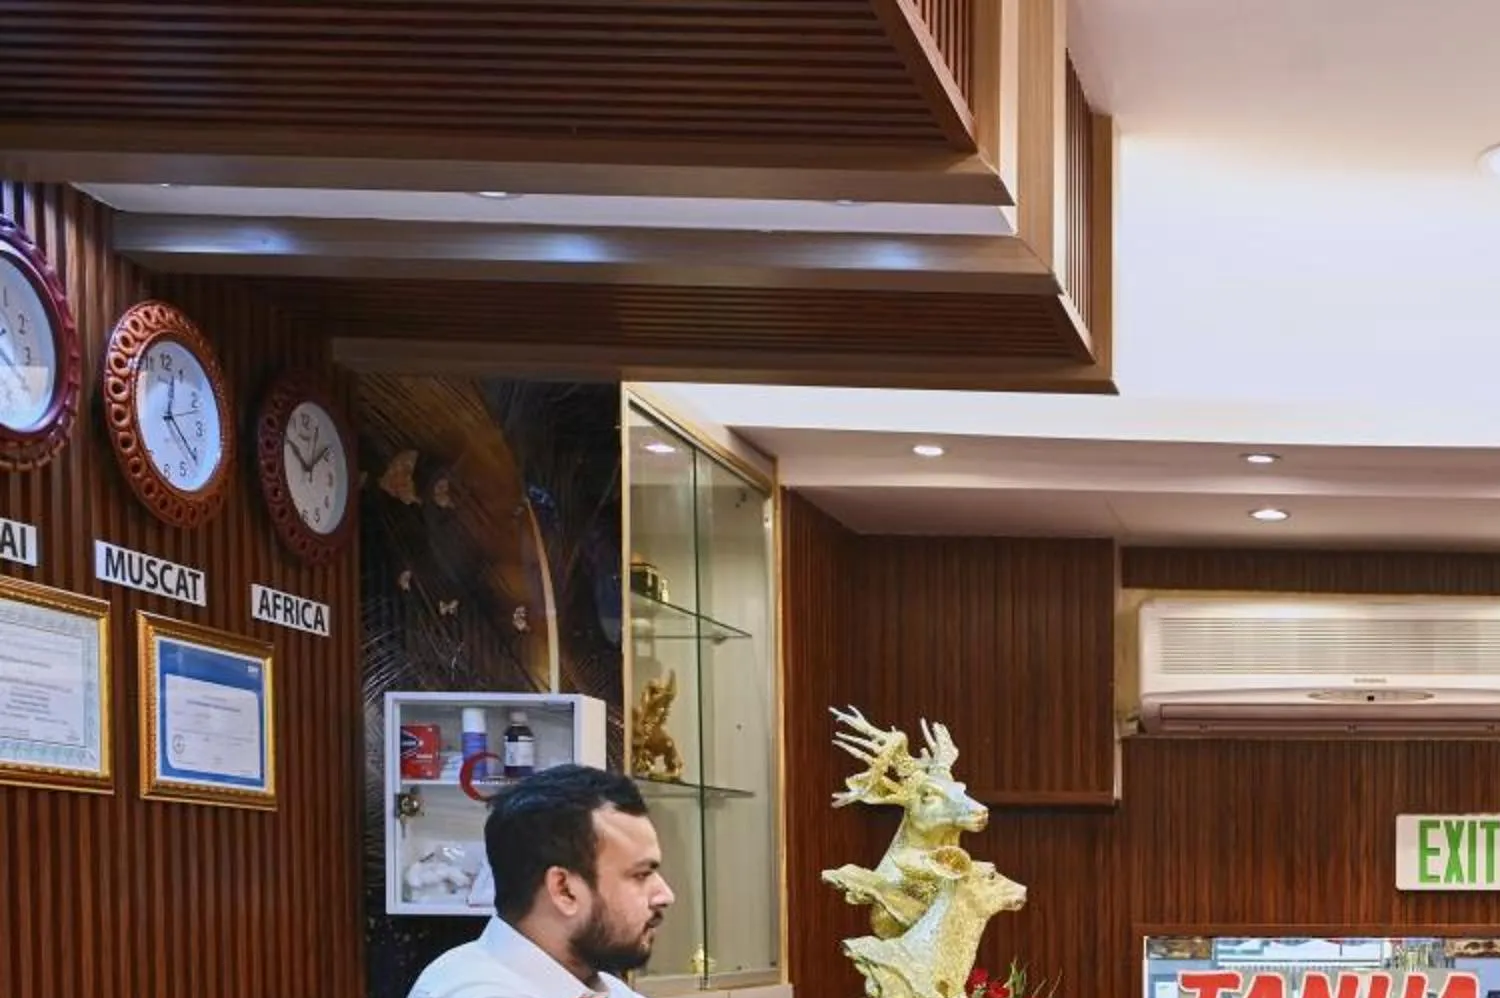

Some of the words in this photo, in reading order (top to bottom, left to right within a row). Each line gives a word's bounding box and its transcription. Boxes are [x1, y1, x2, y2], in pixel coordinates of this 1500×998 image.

[160, 353, 173, 371] 12
[105, 546, 201, 601] MUSCAT
[257, 589, 327, 632] AFRICA
